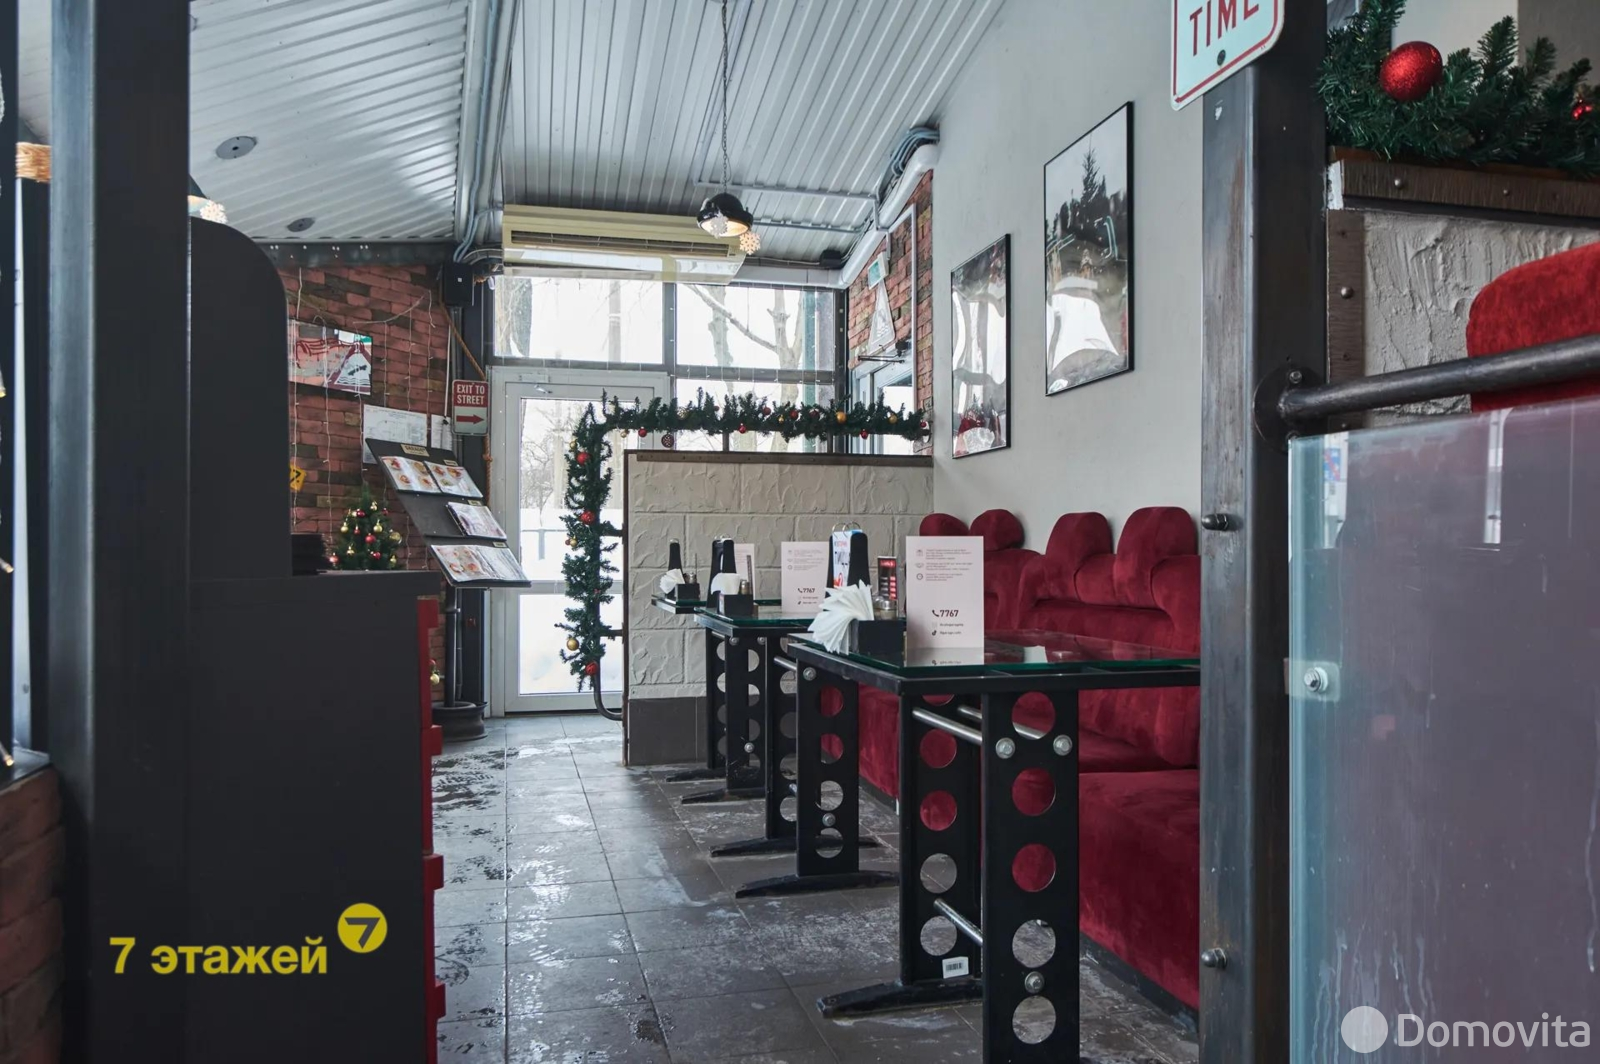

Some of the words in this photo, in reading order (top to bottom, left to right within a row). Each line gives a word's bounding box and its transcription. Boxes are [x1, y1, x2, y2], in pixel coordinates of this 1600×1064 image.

[457, 384, 473, 394] EXIT
[475, 385, 485, 395] TO
[457, 394, 485, 405] STREET
[939, 609, 959, 617] 7767
